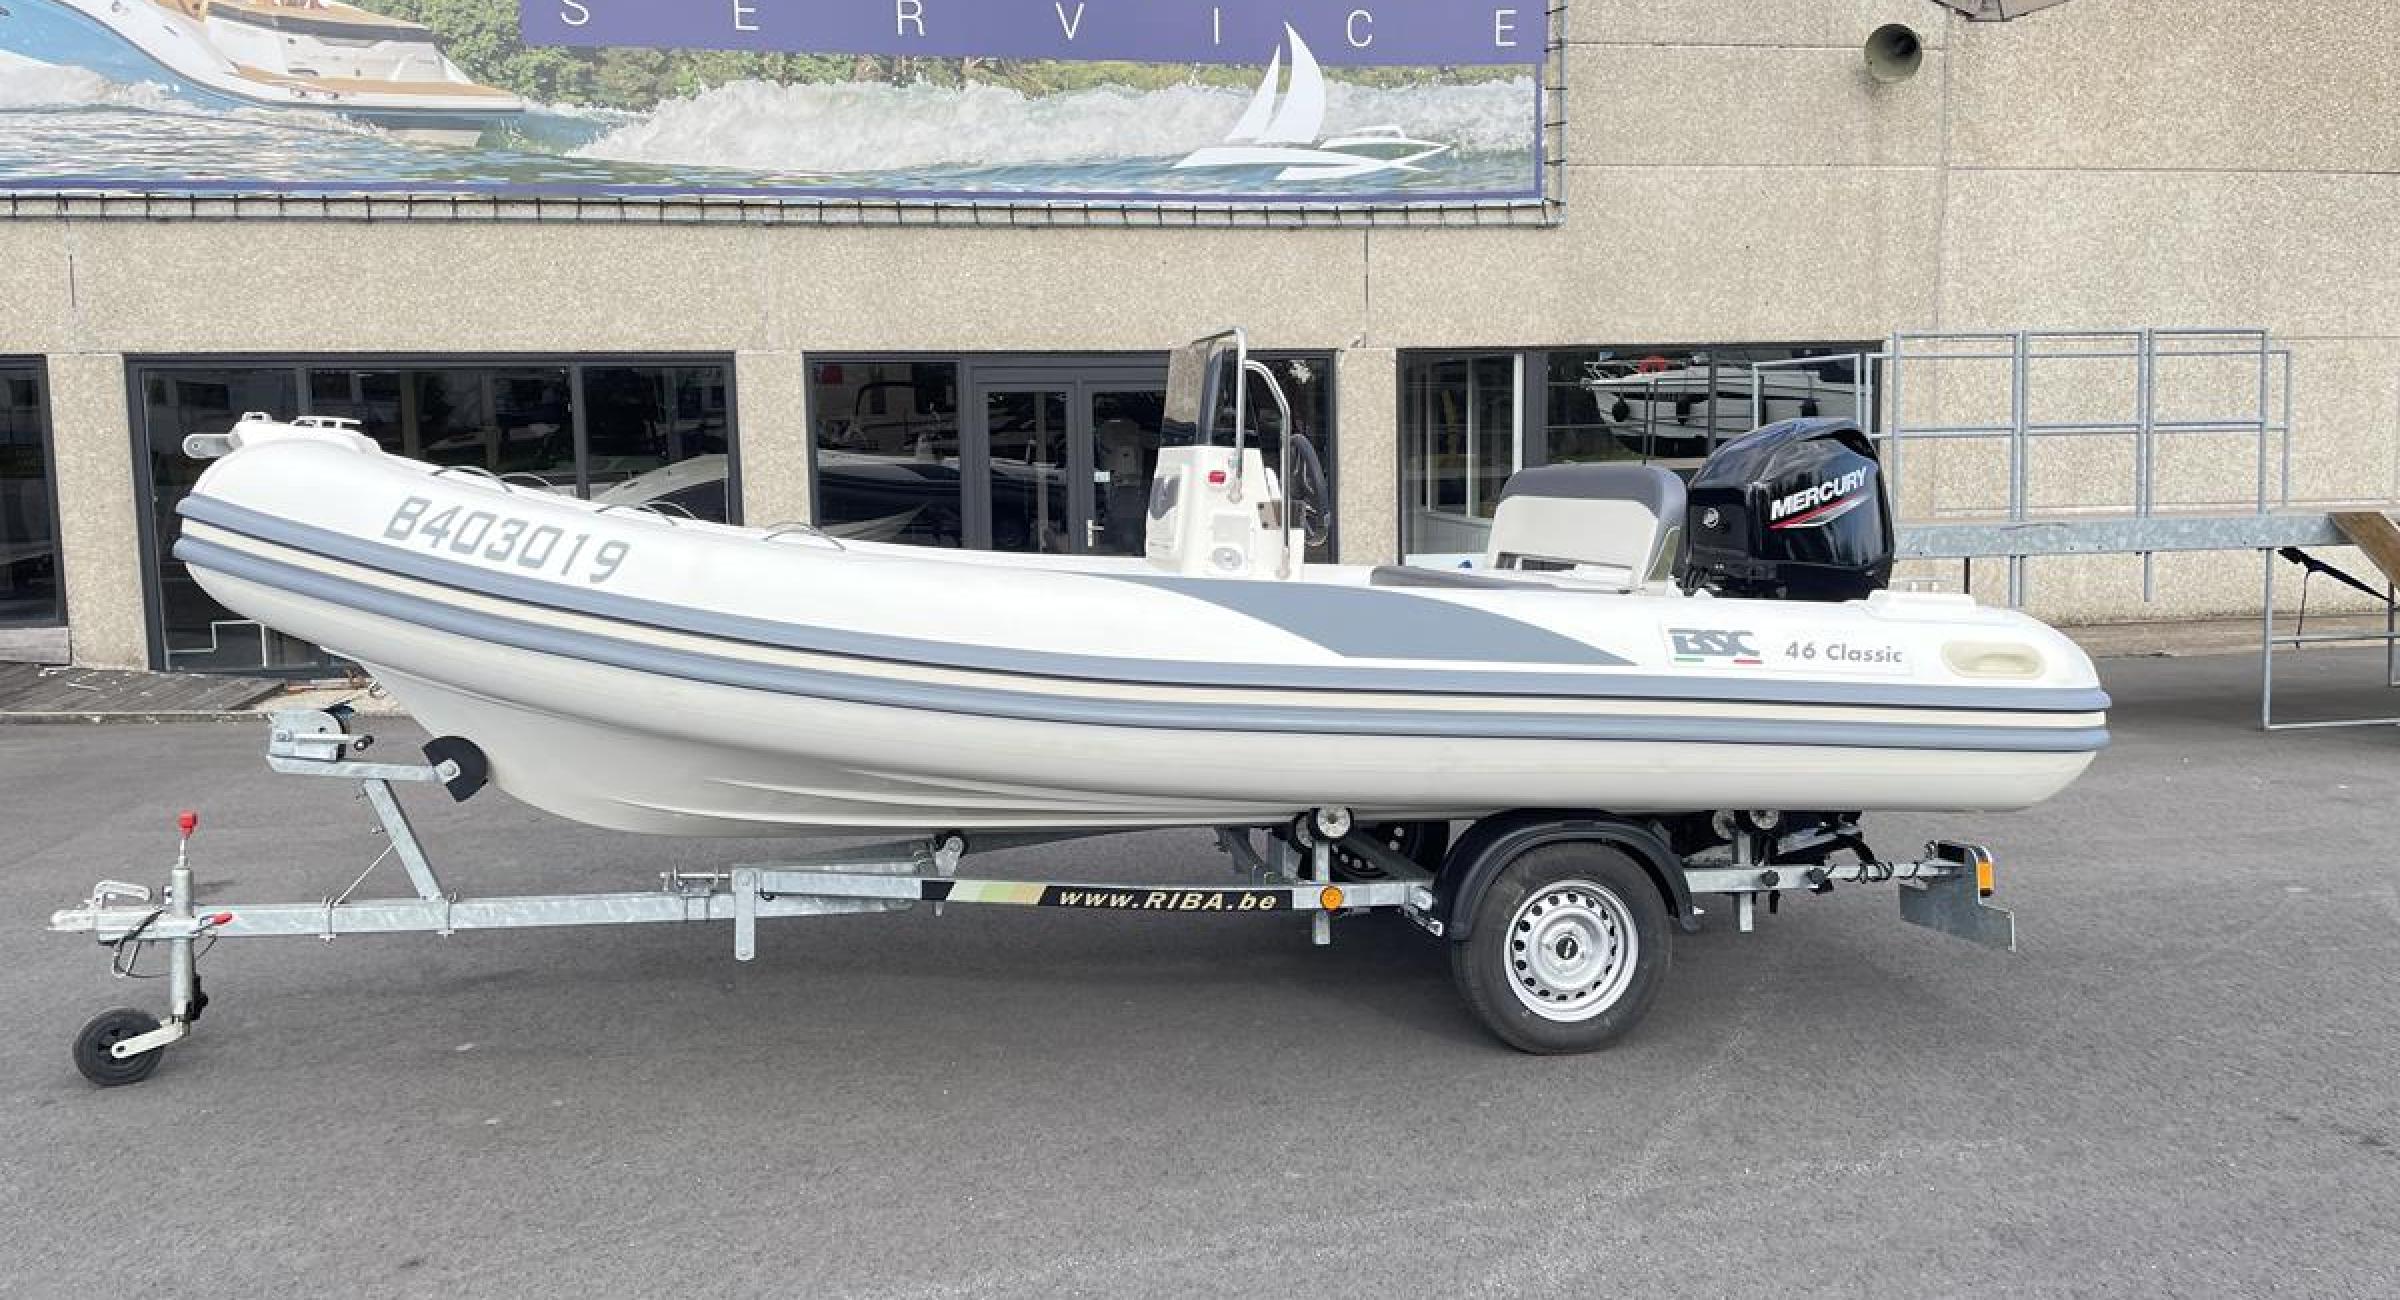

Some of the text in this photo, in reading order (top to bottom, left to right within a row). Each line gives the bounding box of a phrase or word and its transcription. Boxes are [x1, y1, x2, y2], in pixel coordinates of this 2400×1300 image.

[560, 0, 1518, 47] SERVICE
[1771, 466, 1867, 520] MERCURY
[384, 496, 631, 584] B403019
[1668, 628, 1761, 657] BSC
[1785, 642, 1903, 663] 46 Classic
[1059, 890, 1277, 910] www.RIBA.be
